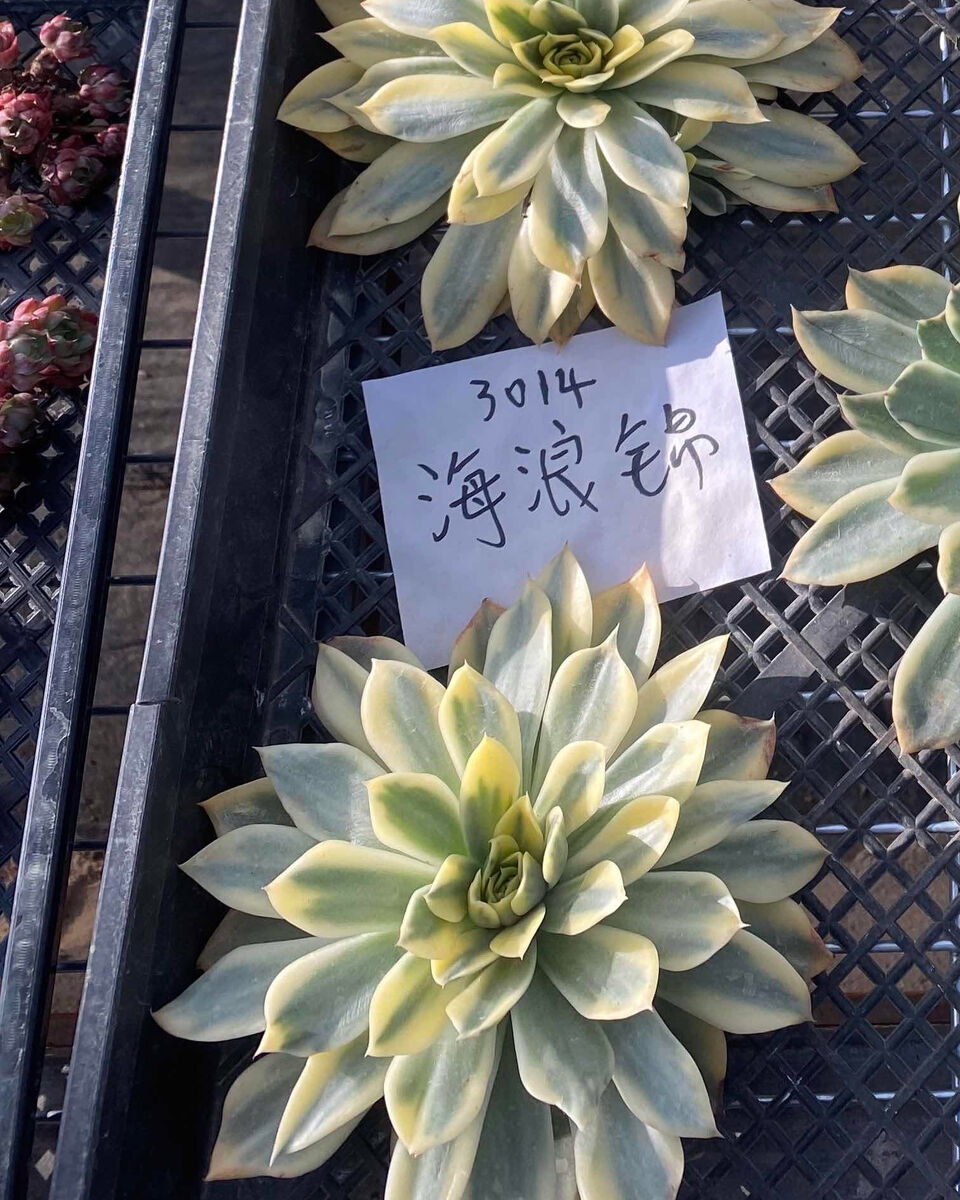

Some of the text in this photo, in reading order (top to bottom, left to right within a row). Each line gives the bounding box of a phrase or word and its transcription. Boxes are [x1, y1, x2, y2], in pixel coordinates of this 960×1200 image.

[469, 367, 597, 422] 3014
[417, 403, 720, 548] 海浪锦
